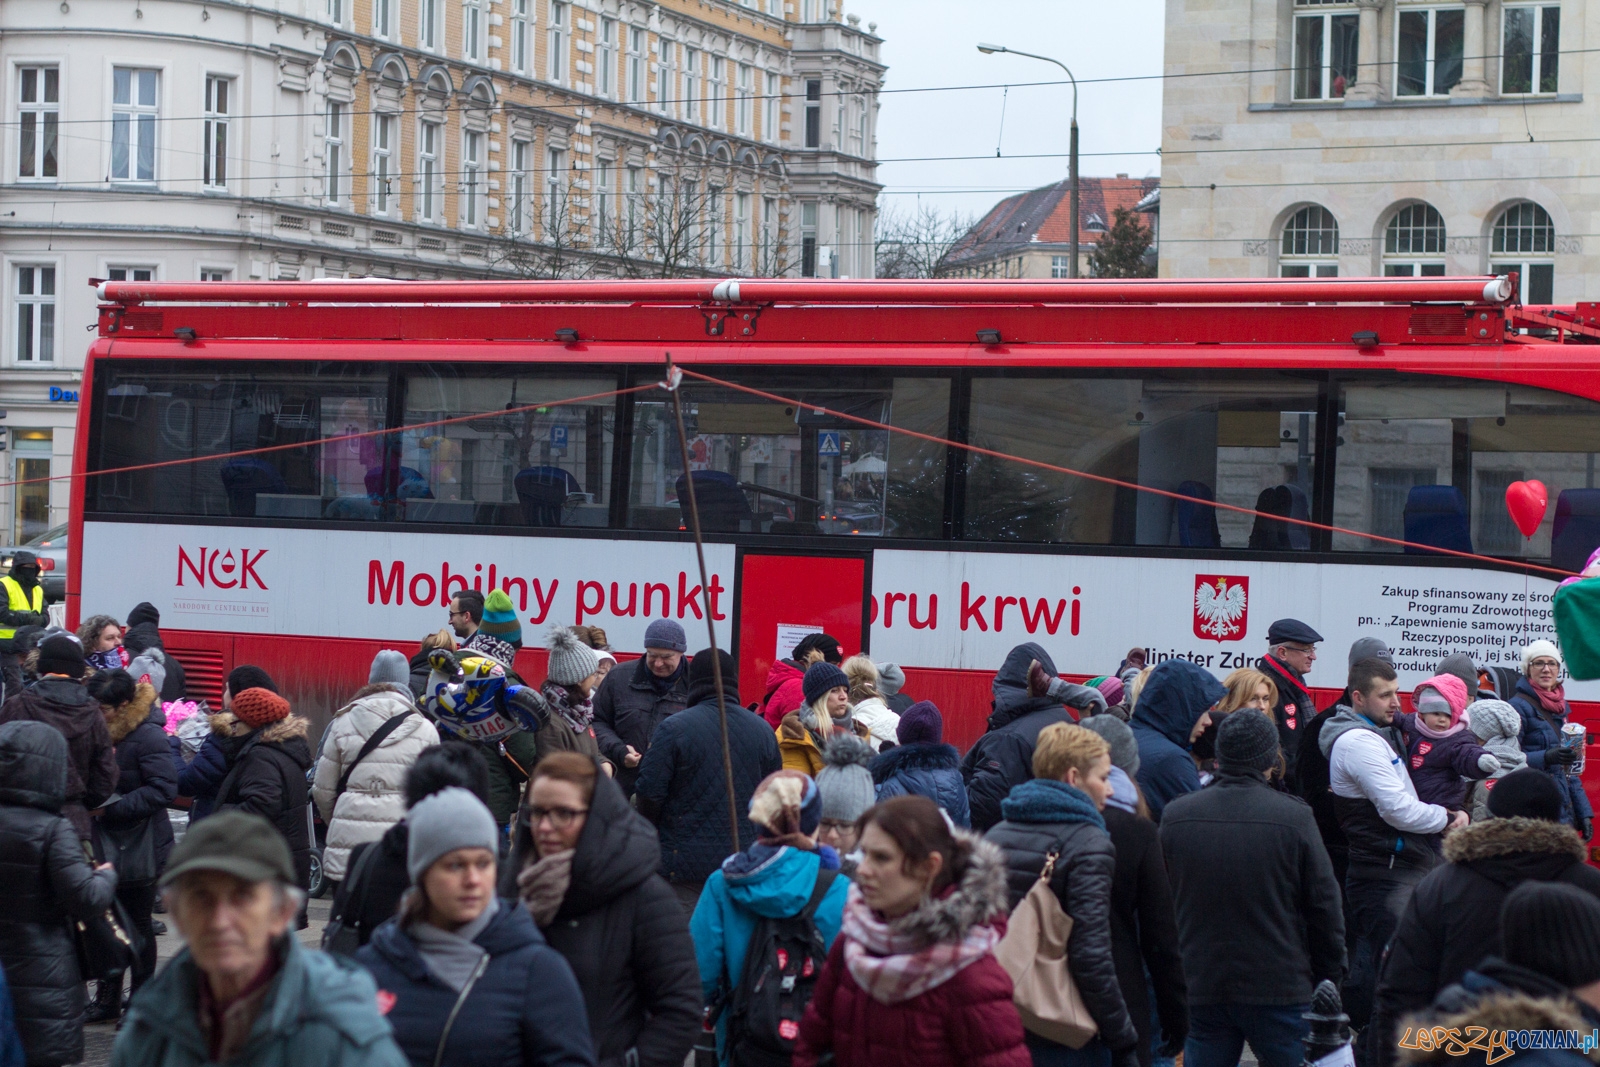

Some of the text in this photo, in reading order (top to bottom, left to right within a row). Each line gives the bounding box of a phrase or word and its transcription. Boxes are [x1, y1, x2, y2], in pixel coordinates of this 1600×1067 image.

[367, 559, 559, 625] Mobilny
[575, 571, 726, 626] punkt
[960, 581, 1081, 636] krwi
[1381, 585, 1420, 600] Zakup
[1422, 587, 1508, 604] sfinansowany
[1511, 592, 1526, 602] ze
[173, 602, 269, 614] NARODOWE CENTRUM KRWI
[1408, 601, 1555, 621] Programu Zdrowotnego
[1358, 616, 1381, 627] pn.:
[1402, 630, 1506, 649] Rzeczypospolitej
[1398, 646, 1449, 658] zakresie
[1485, 649, 1500, 663] jej
